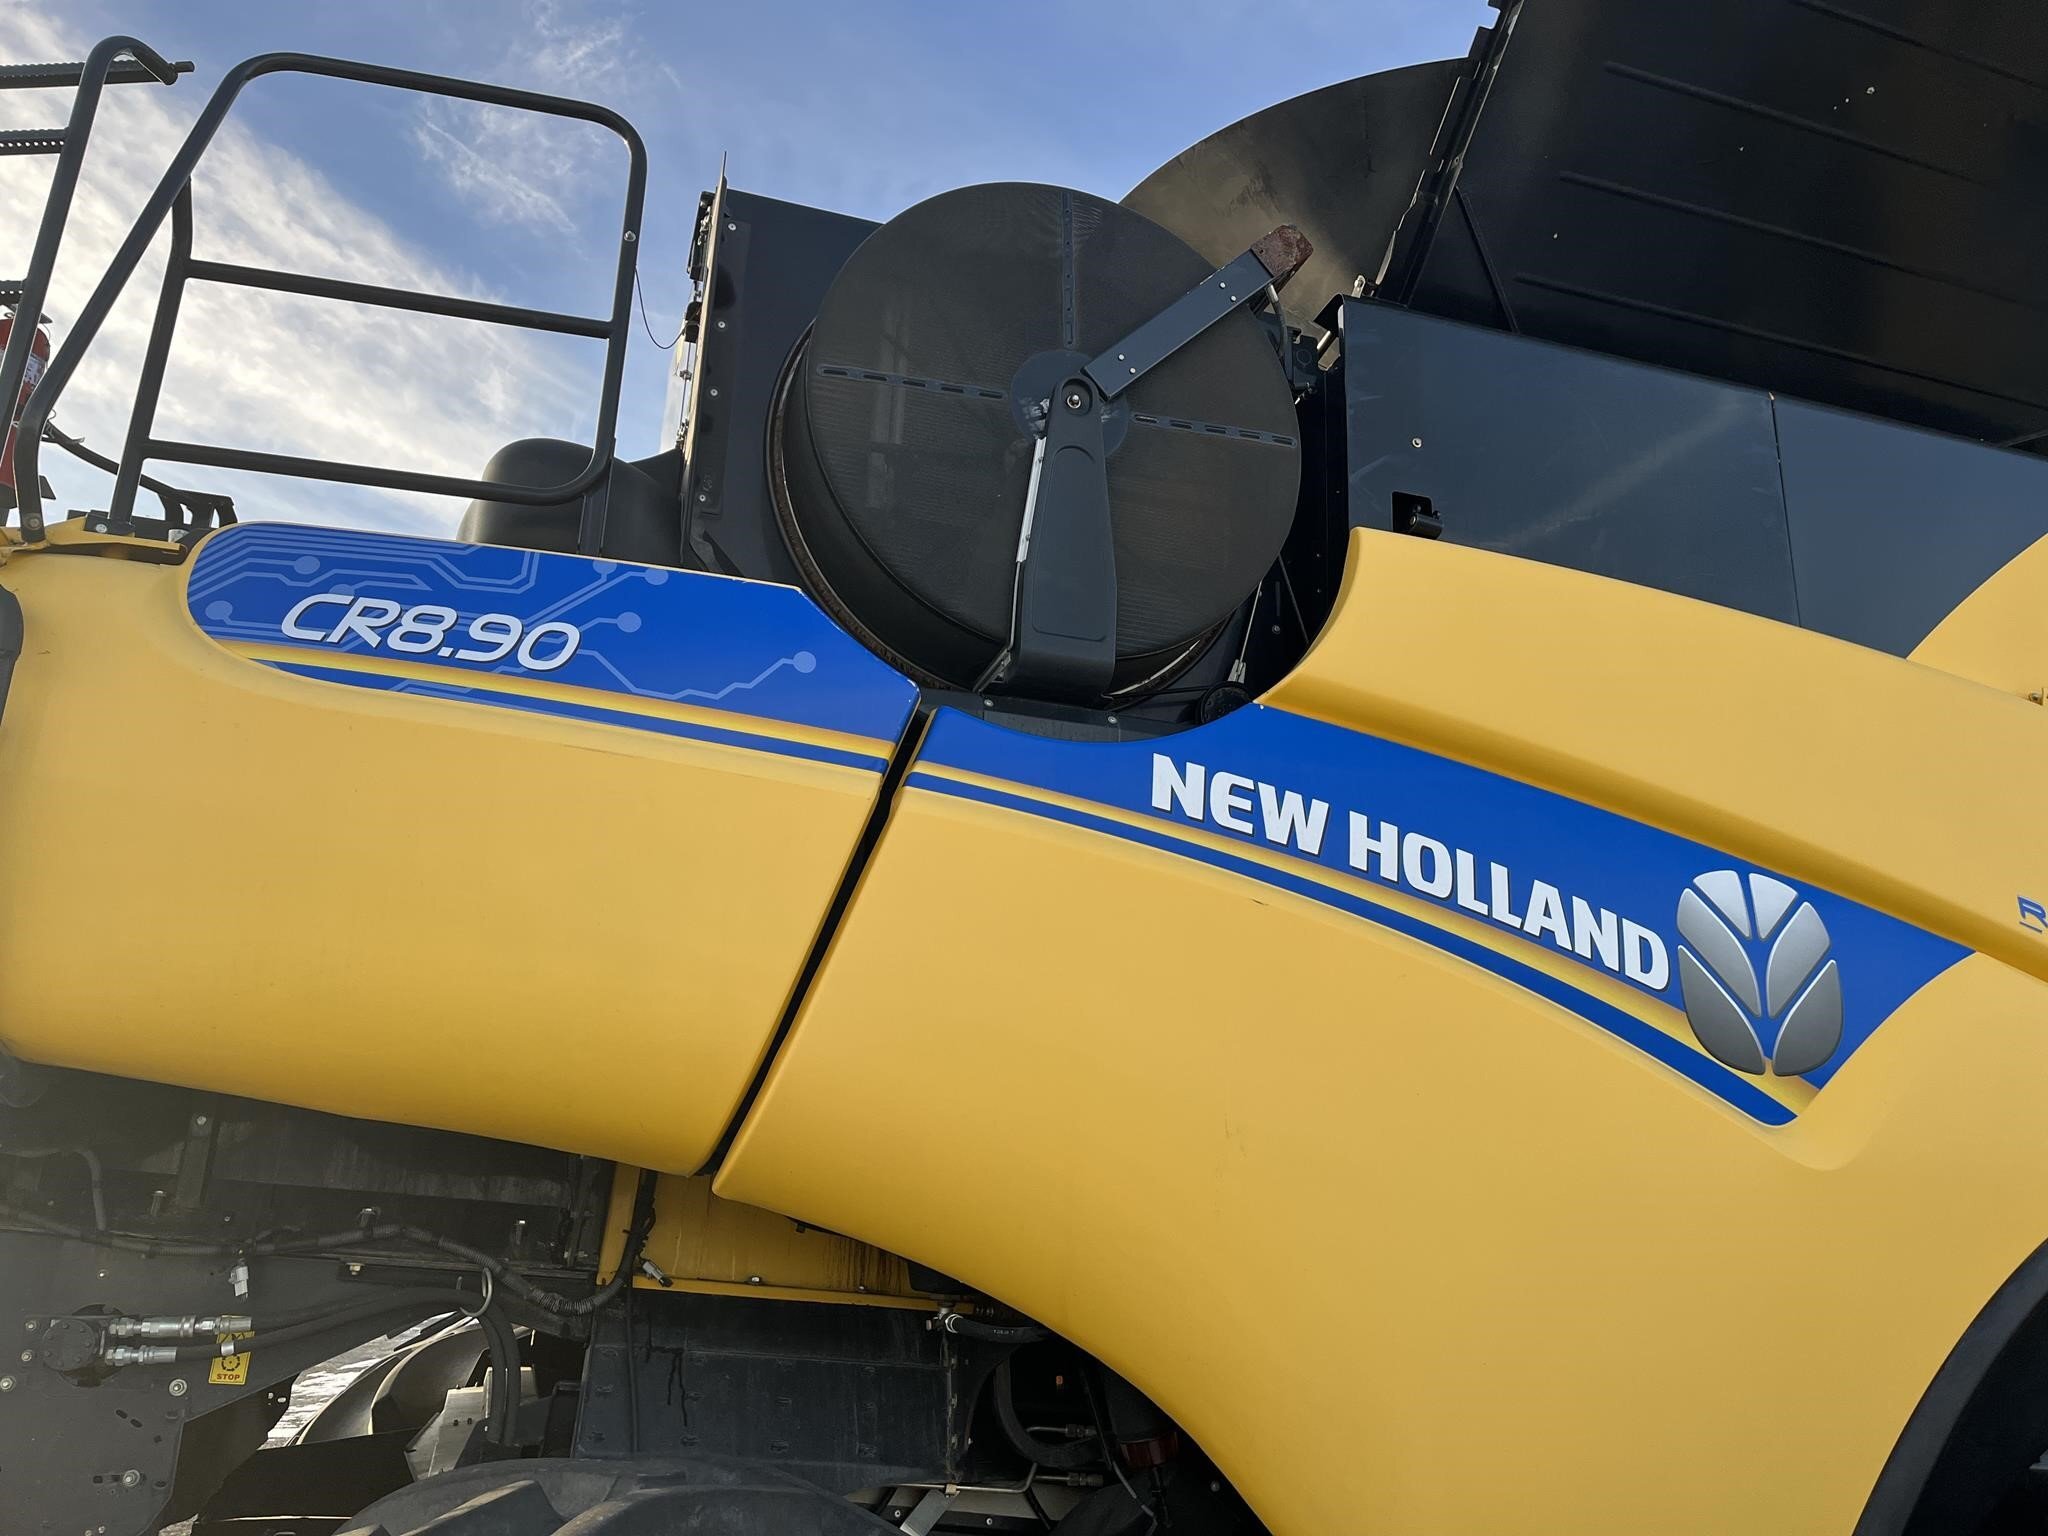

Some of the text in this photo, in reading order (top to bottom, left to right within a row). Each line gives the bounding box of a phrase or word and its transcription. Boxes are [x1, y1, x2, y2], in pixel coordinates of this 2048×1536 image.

[280, 593, 582, 671] CR8.90
[1151, 752, 1670, 991] NEW HOLLAND
[216, 1373, 241, 1381] STOP
